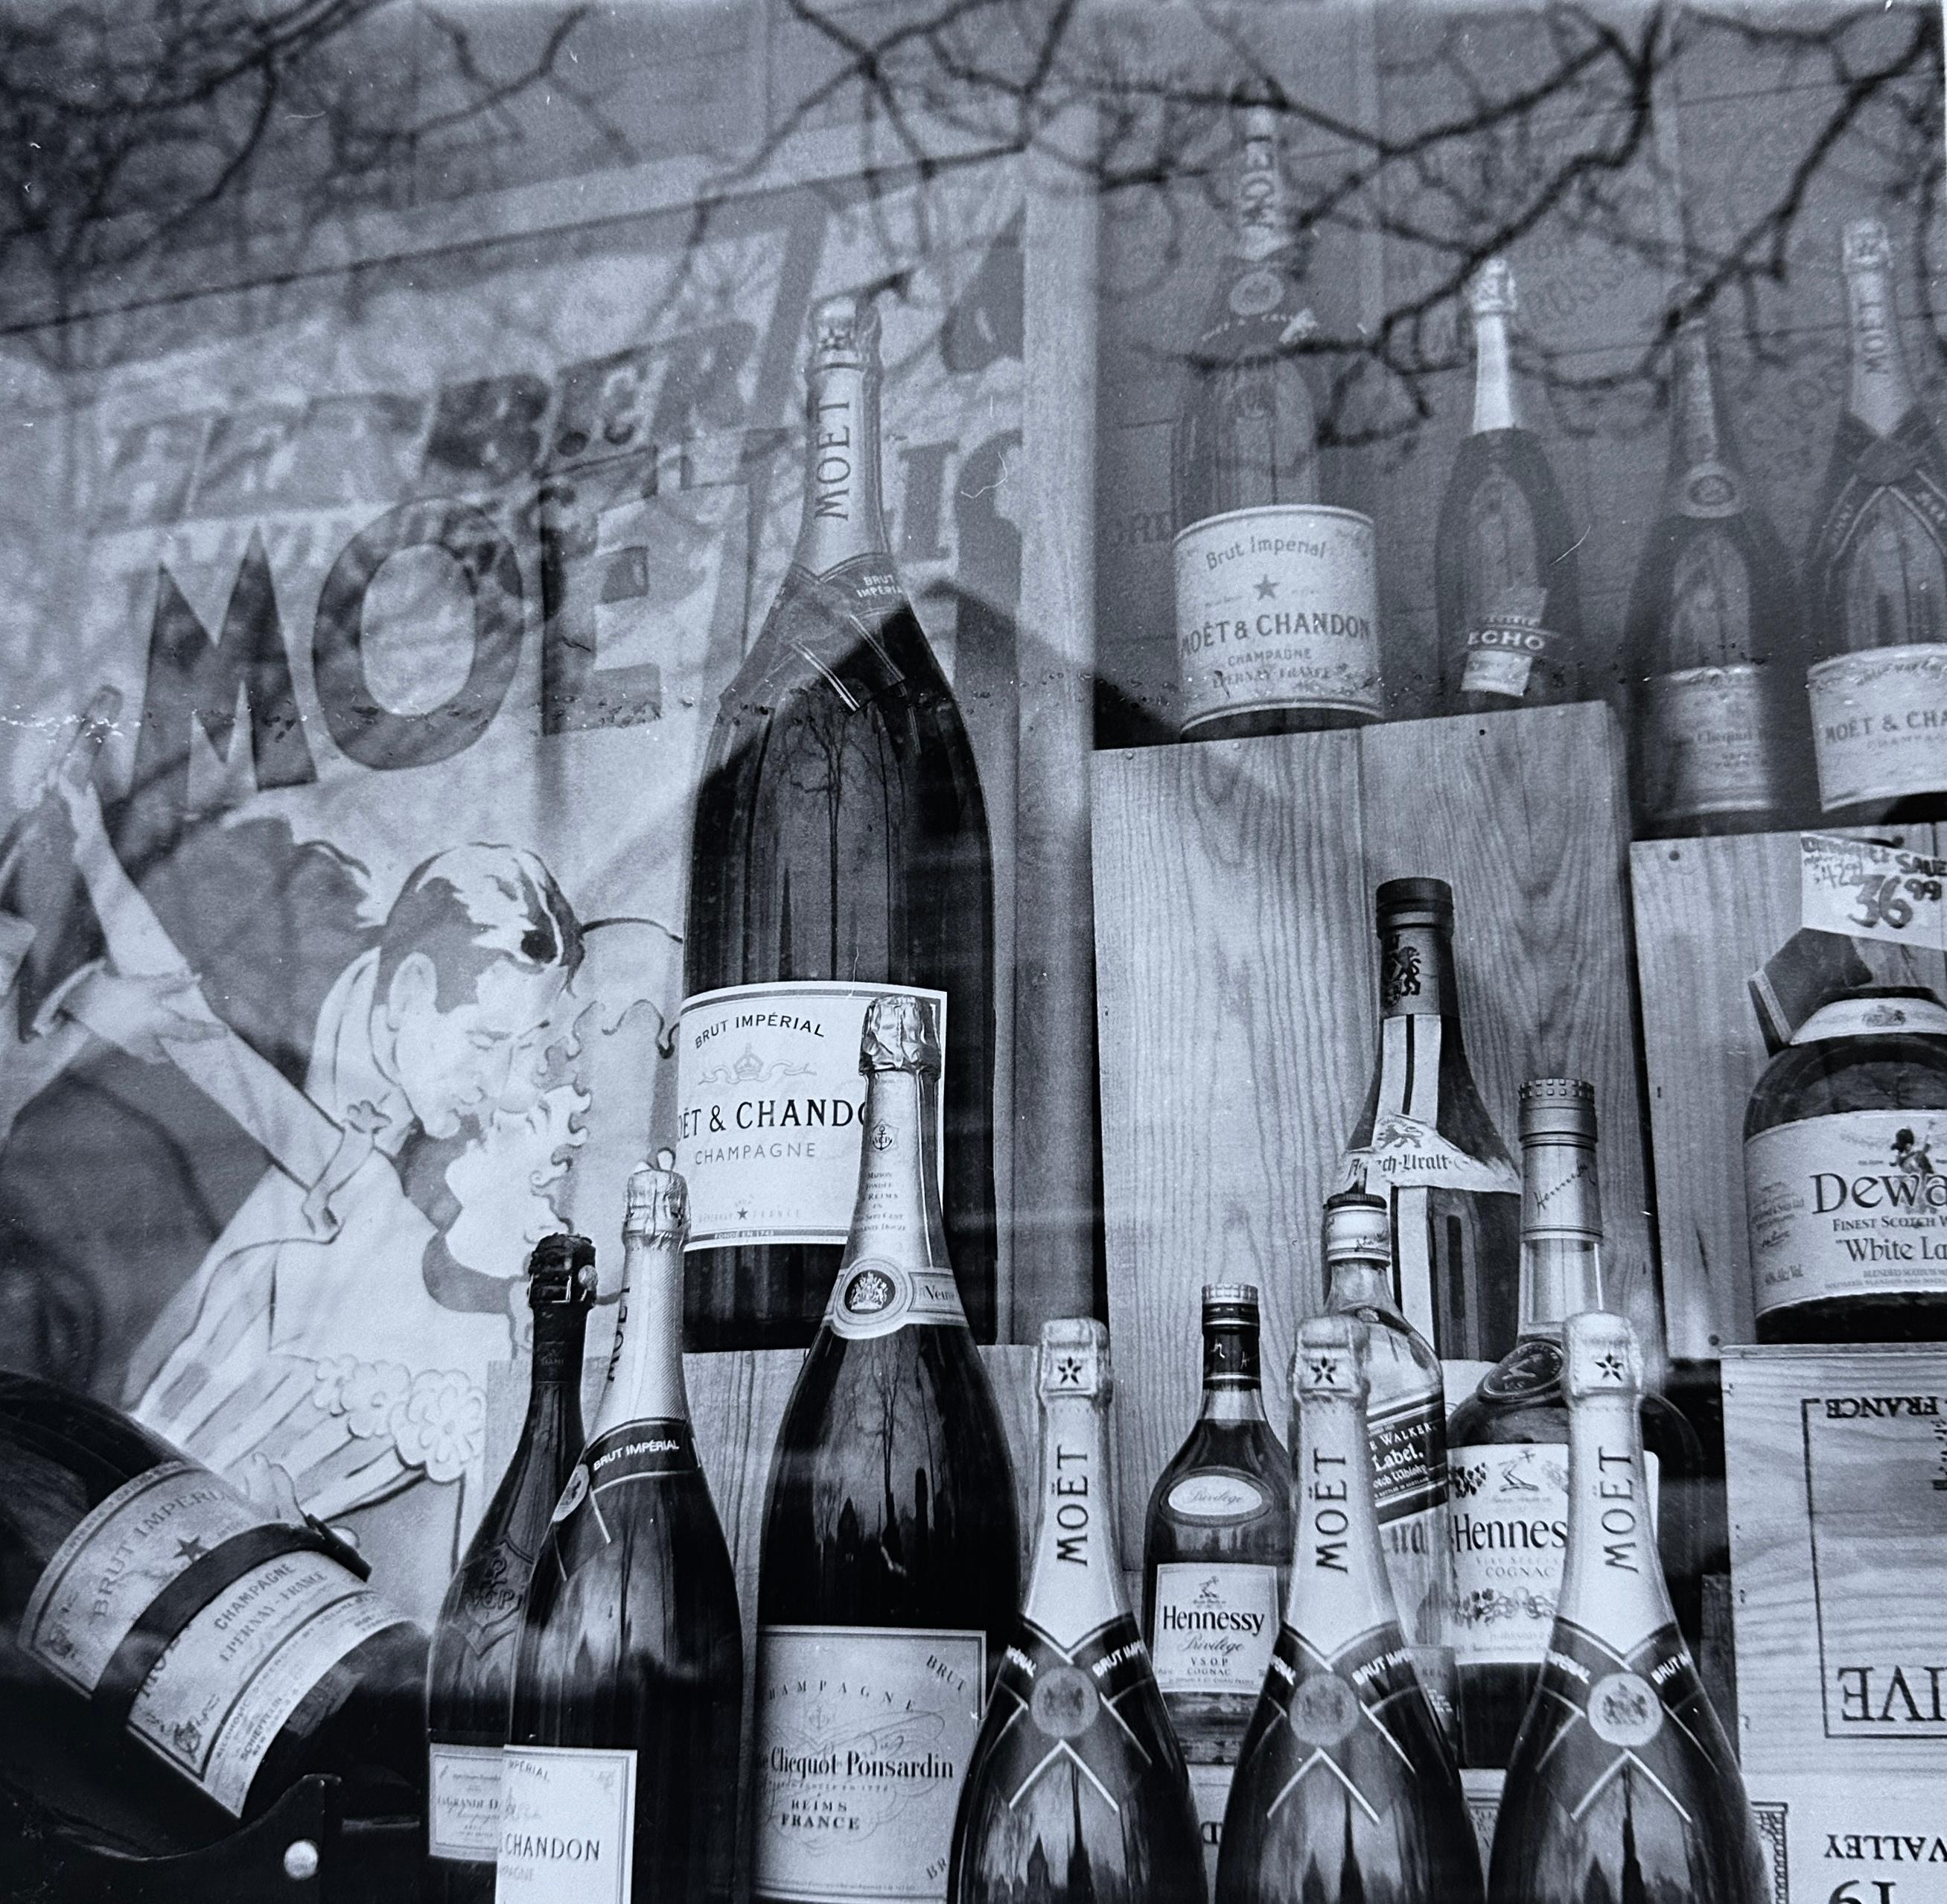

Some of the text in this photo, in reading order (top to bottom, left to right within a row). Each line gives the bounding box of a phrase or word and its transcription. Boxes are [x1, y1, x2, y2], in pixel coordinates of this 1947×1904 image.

[1234, 620, 1249, 640] &
[1256, 612, 1371, 641] CHANDON
[1228, 647, 1313, 668] CHAMPAGNE
[1881, 714, 1899, 732] &
[695, 1011, 825, 1049] BRUT IMPÉRIAL
[709, 1104, 727, 1133] &
[695, 1142, 816, 1165] CHAMPAGNE
[1832, 1217, 1878, 1232] FINEST
[1826, 1396, 1939, 1419] FRANCE
[1379, 1421, 1433, 1446] WALKER
[593, 1439, 680, 1472] BRUT IMPÉRIAL
[1371, 1442, 1424, 1472] Label.
[1057, 1445, 1089, 1567] MOËT
[1308, 1447, 1349, 1574] MOËT
[1592, 1445, 1639, 1573] MOËT
[1485, 1566, 1555, 1578] COGNAC
[214, 1561, 297, 1631] CHAMPAGNE
[1162, 1605, 1266, 1637] Hennessy
[925, 1654, 967, 1693] BRUT
[1187, 1668, 1231, 1676] COGNAC
[846, 1750, 954, 1779] Ponsardin
[791, 1799, 848, 1812] REIMS
[781, 1812, 861, 1831] FRANCE
[506, 1832, 600, 1862] CHANDON
[1824, 1834, 1947, 1861] VALLEY
[925, 1856, 948, 1880] BR
